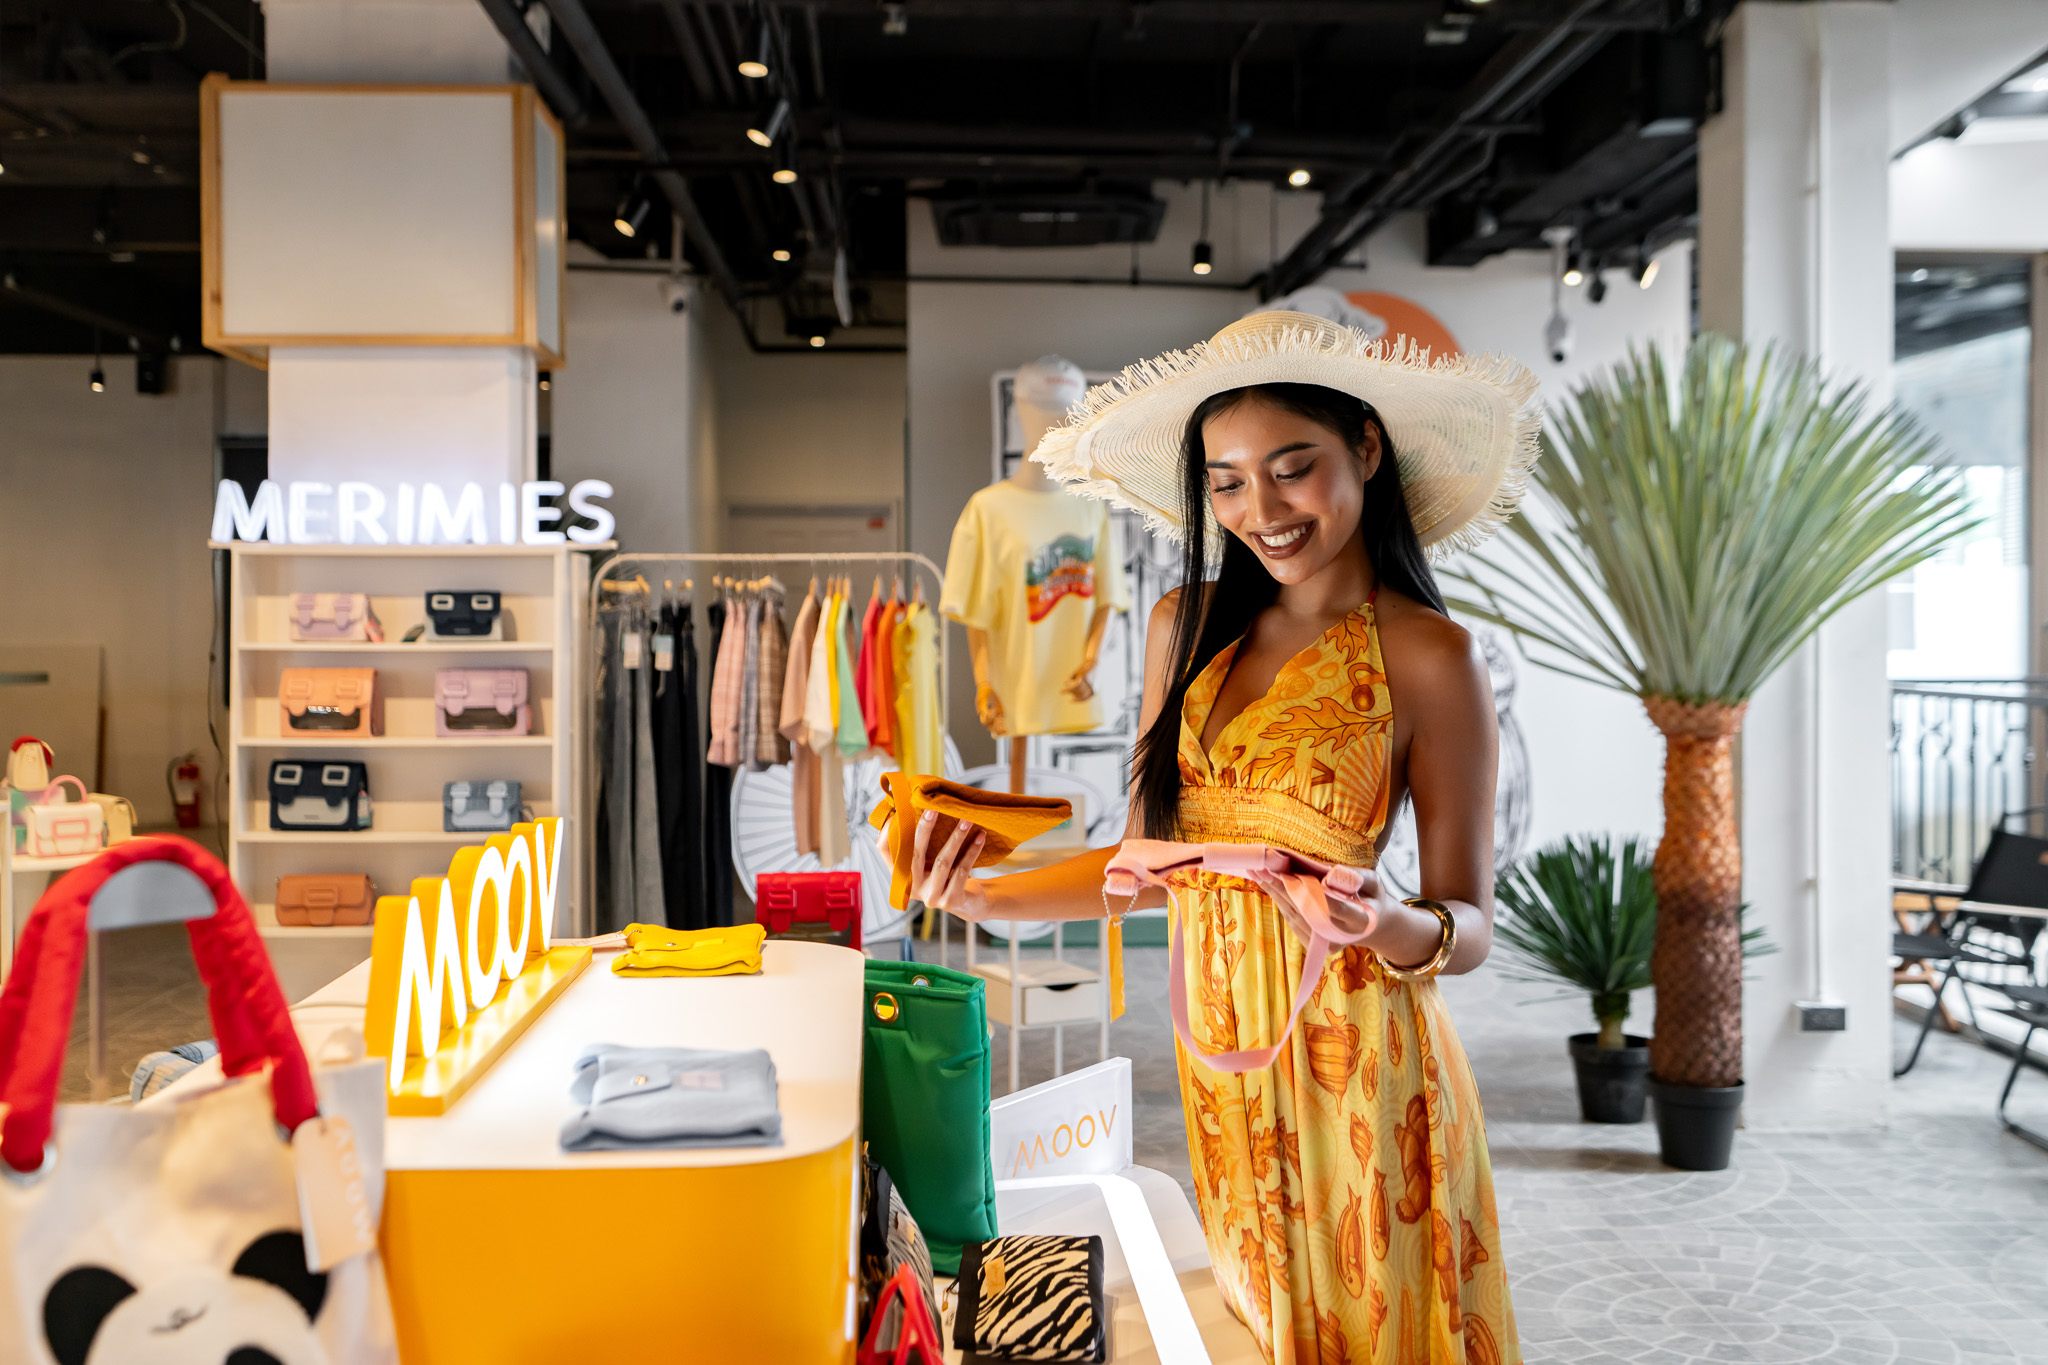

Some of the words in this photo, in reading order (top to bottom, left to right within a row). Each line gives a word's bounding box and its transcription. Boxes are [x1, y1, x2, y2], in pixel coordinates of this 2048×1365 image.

[211, 479, 616, 545] MERIMIES
[389, 817, 564, 1096] MOOV
[1012, 1104, 1117, 1178] MOOV
